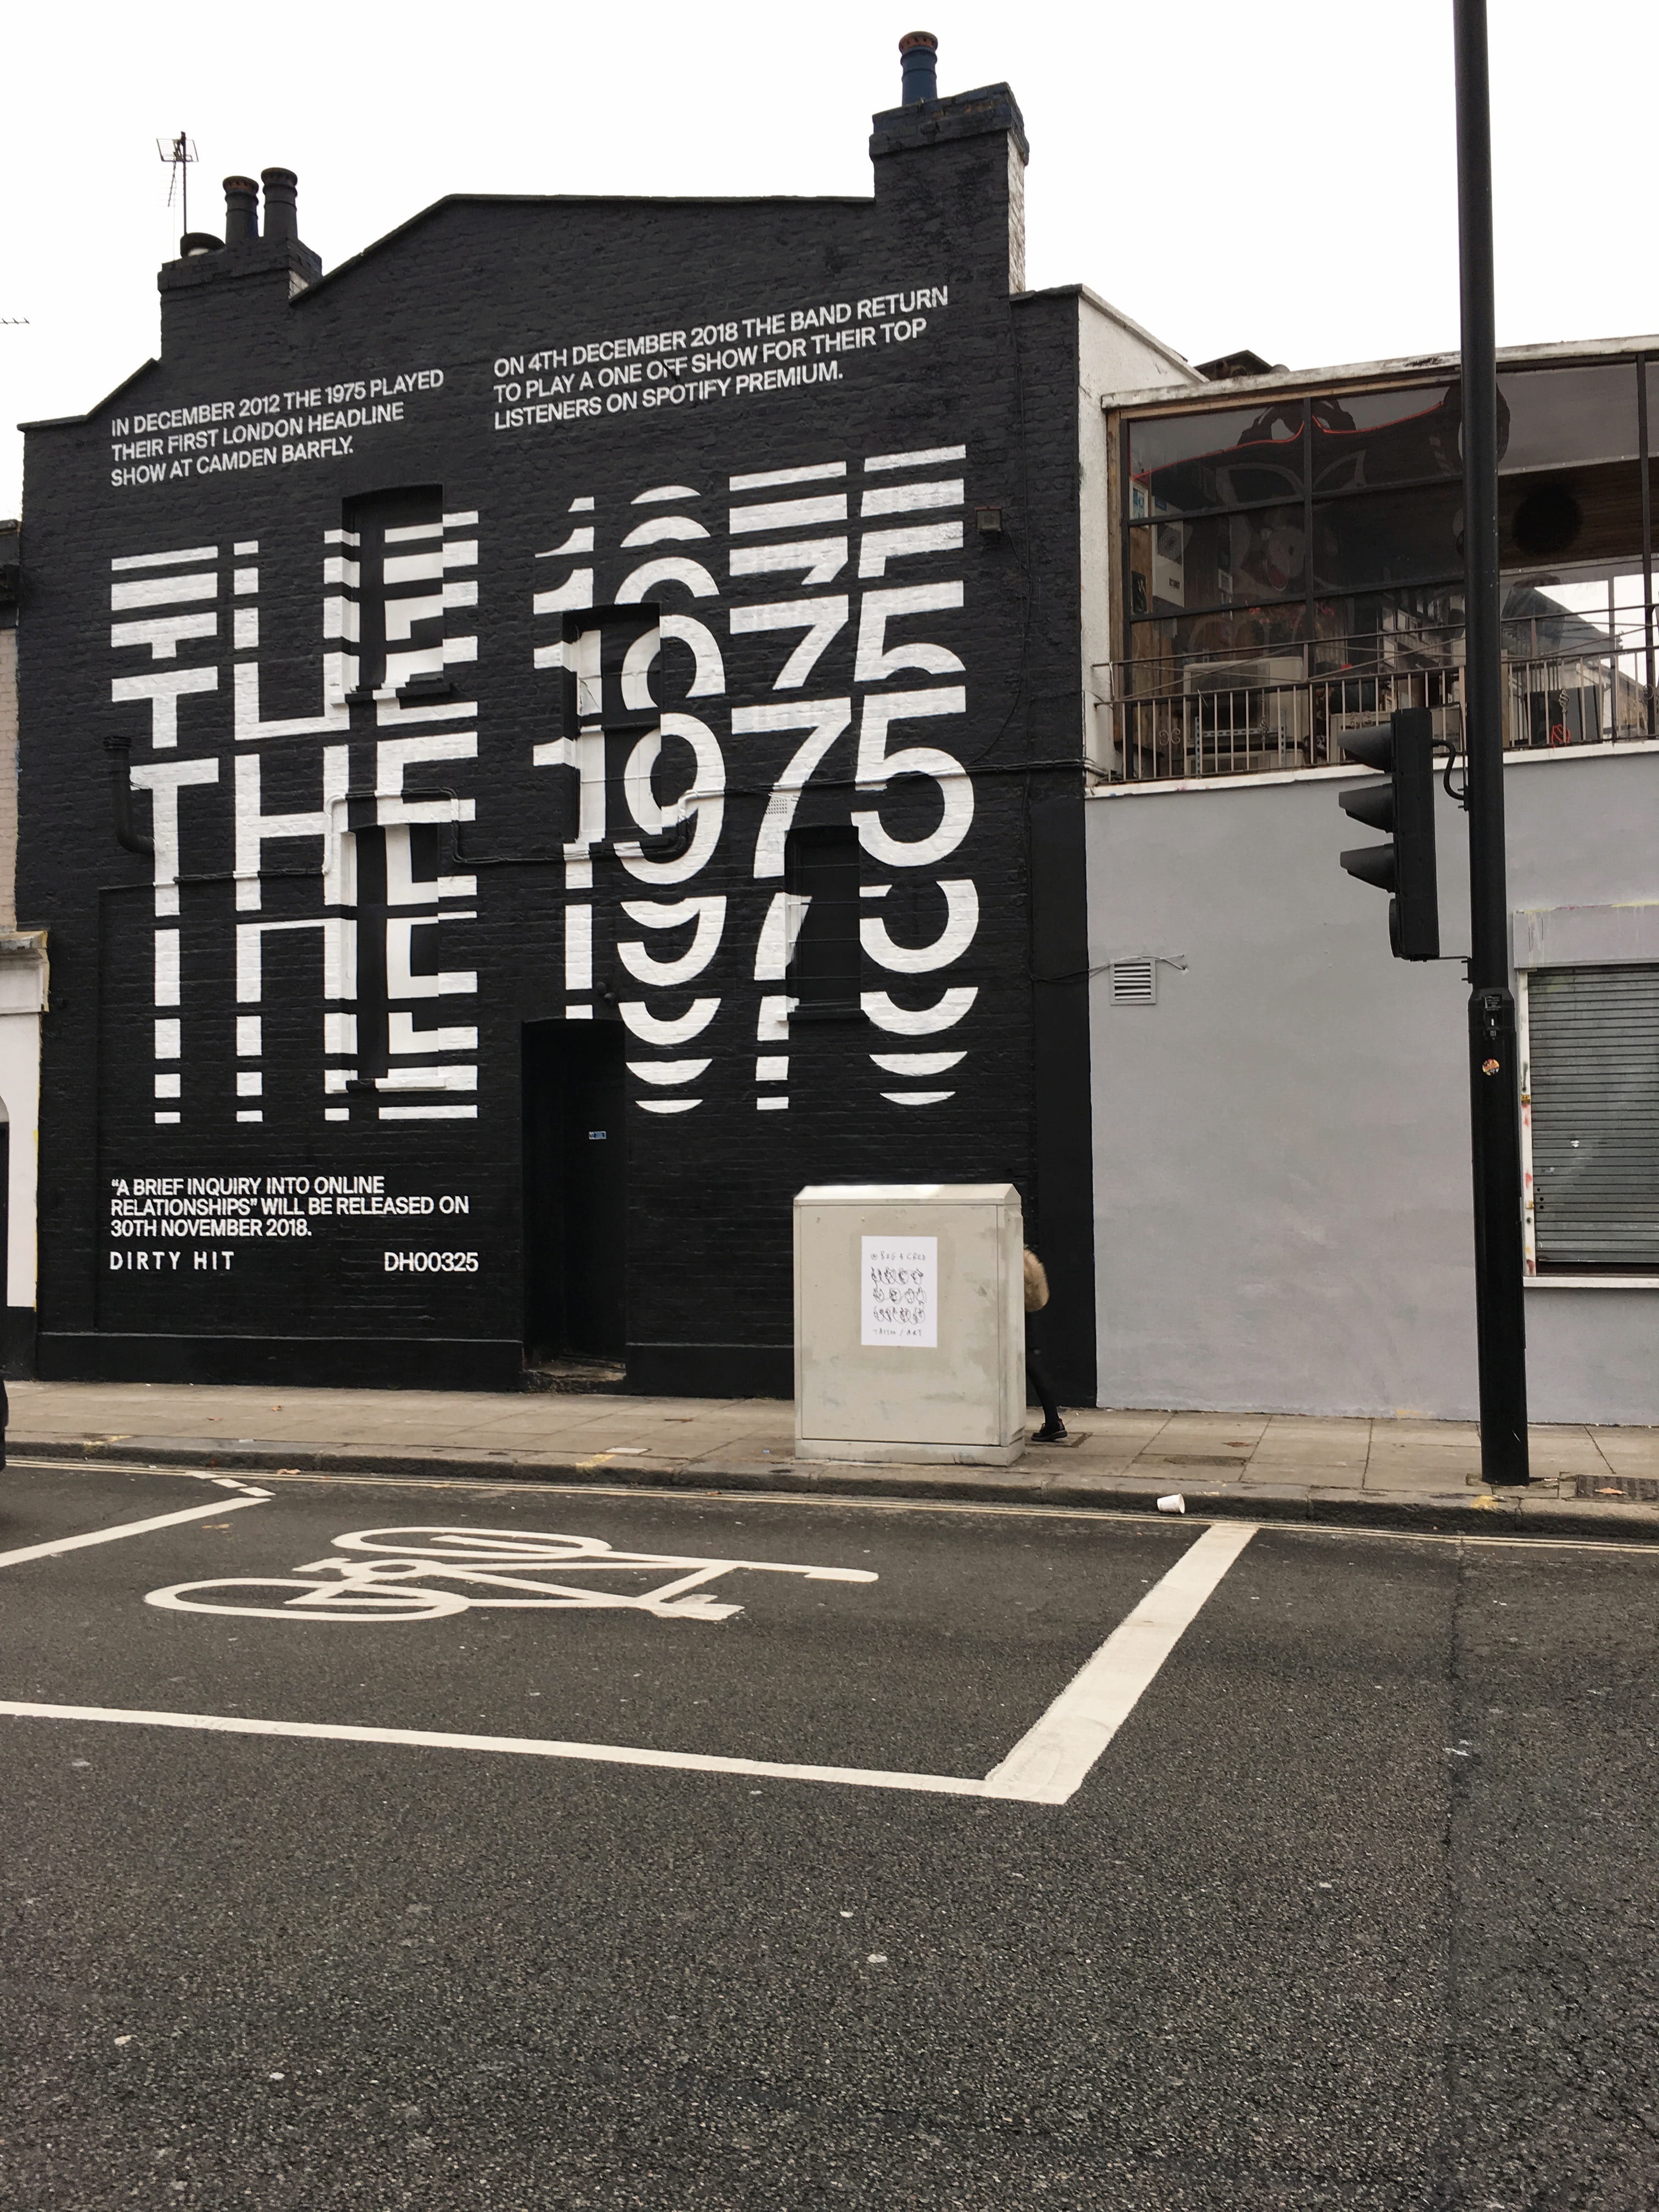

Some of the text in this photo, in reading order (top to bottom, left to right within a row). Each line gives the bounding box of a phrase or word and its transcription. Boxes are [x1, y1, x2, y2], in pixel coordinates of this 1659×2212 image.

[494, 285, 948, 377] ON 4TH DECEMBER 2018 THE BAND RETURN
[493, 317, 927, 403] TO PLAY A ONE OFF SHOW FOR THEIR TOP
[112, 369, 444, 437] IN DECEMBER 2012 THE 1975 PLAYED
[494, 360, 843, 430] LISTENERS ON SPOTIFY PREMIUM.
[111, 401, 404, 461] THEIR FIRST LONDON HEADLINE
[111, 435, 353, 487] SHOW AT CAMDEN BARFLY.
[133, 1178, 184, 1196] BRIEF
[187, 1177, 262, 1197] INQUIRY
[267, 1176, 310, 1194] INTO
[314, 1176, 385, 1194] ONLINE
[260, 1197, 305, 1215] WILL
[308, 1197, 332, 1215] BE
[336, 1196, 435, 1215] RELEASED
[439, 1195, 469, 1214] ON
[111, 1218, 312, 1237] 30TH NOVEMBER 2018.
[110, 1251, 234, 1270] DIRTY HIT
[384, 1252, 479, 1272] DH00325
